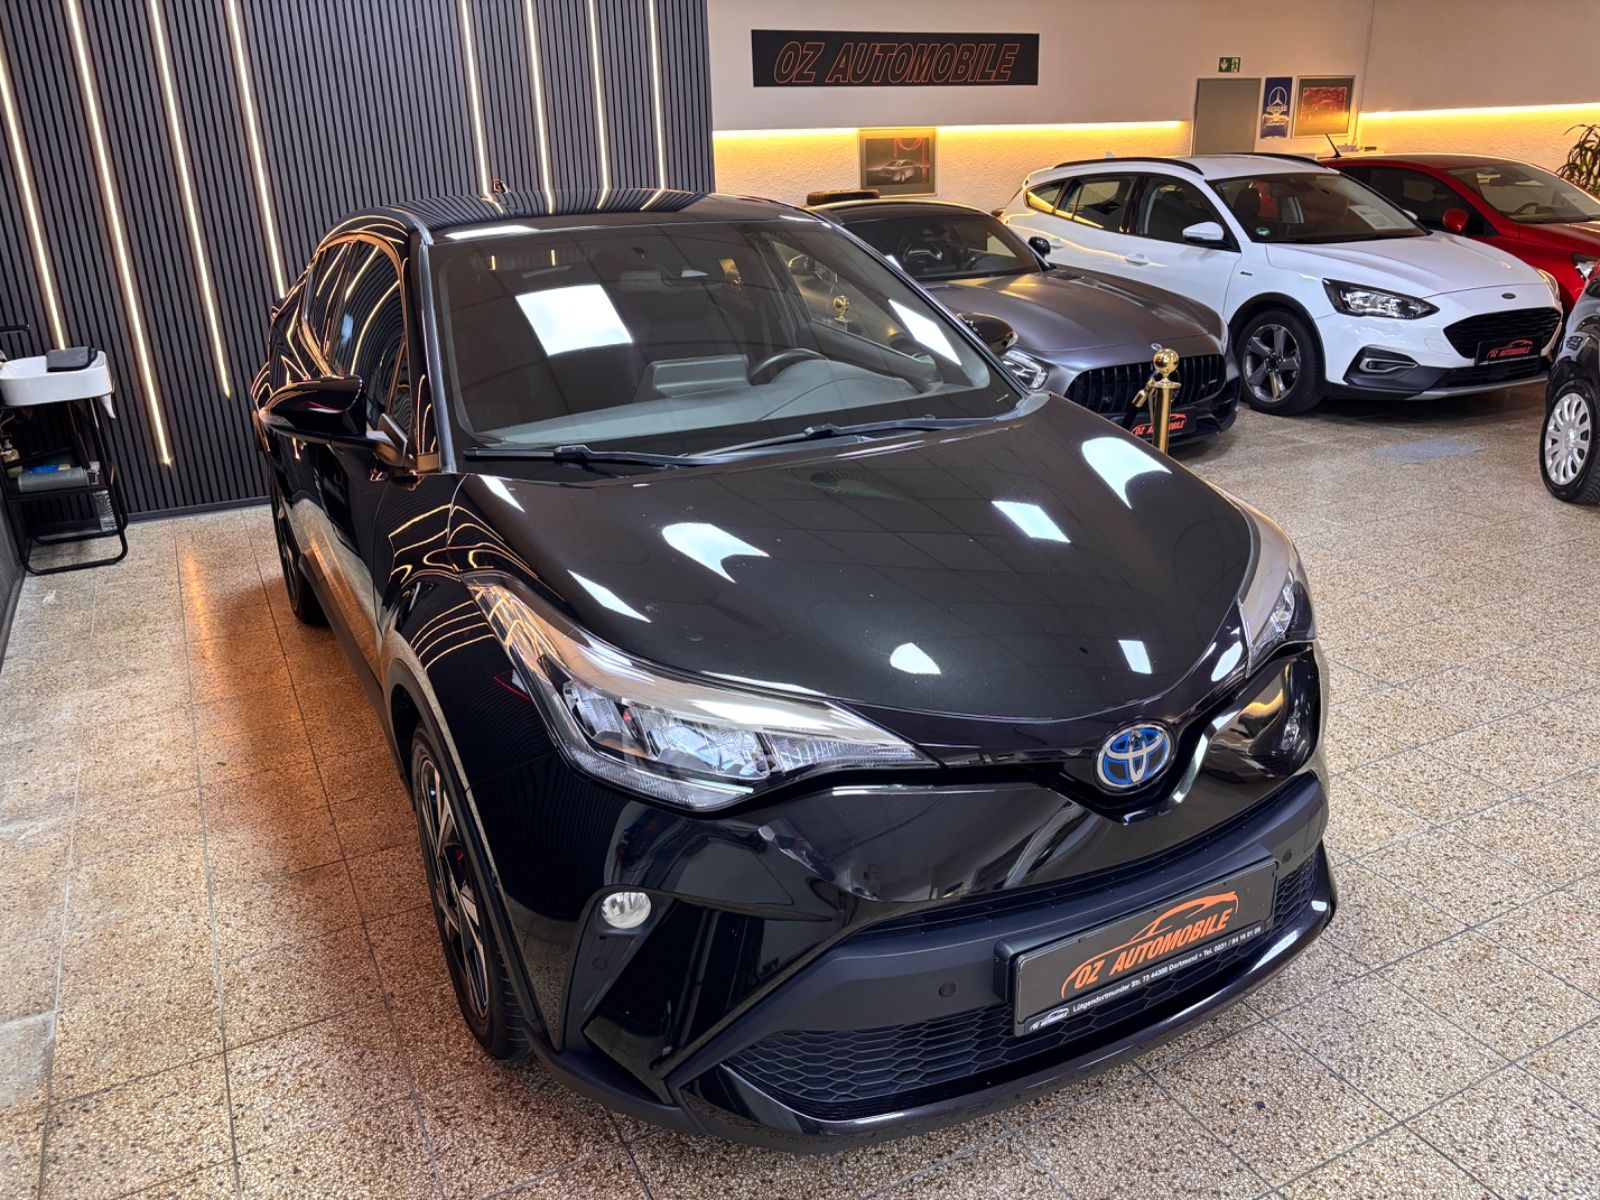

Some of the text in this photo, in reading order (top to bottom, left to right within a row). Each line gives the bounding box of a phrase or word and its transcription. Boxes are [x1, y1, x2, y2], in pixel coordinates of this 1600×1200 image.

[773, 41, 1020, 84] OZ AUTOMOBILE
[1074, 908, 1233, 990] OZ AUTOMOBILE
[1169, 954, 1198, 971] Dortmund
